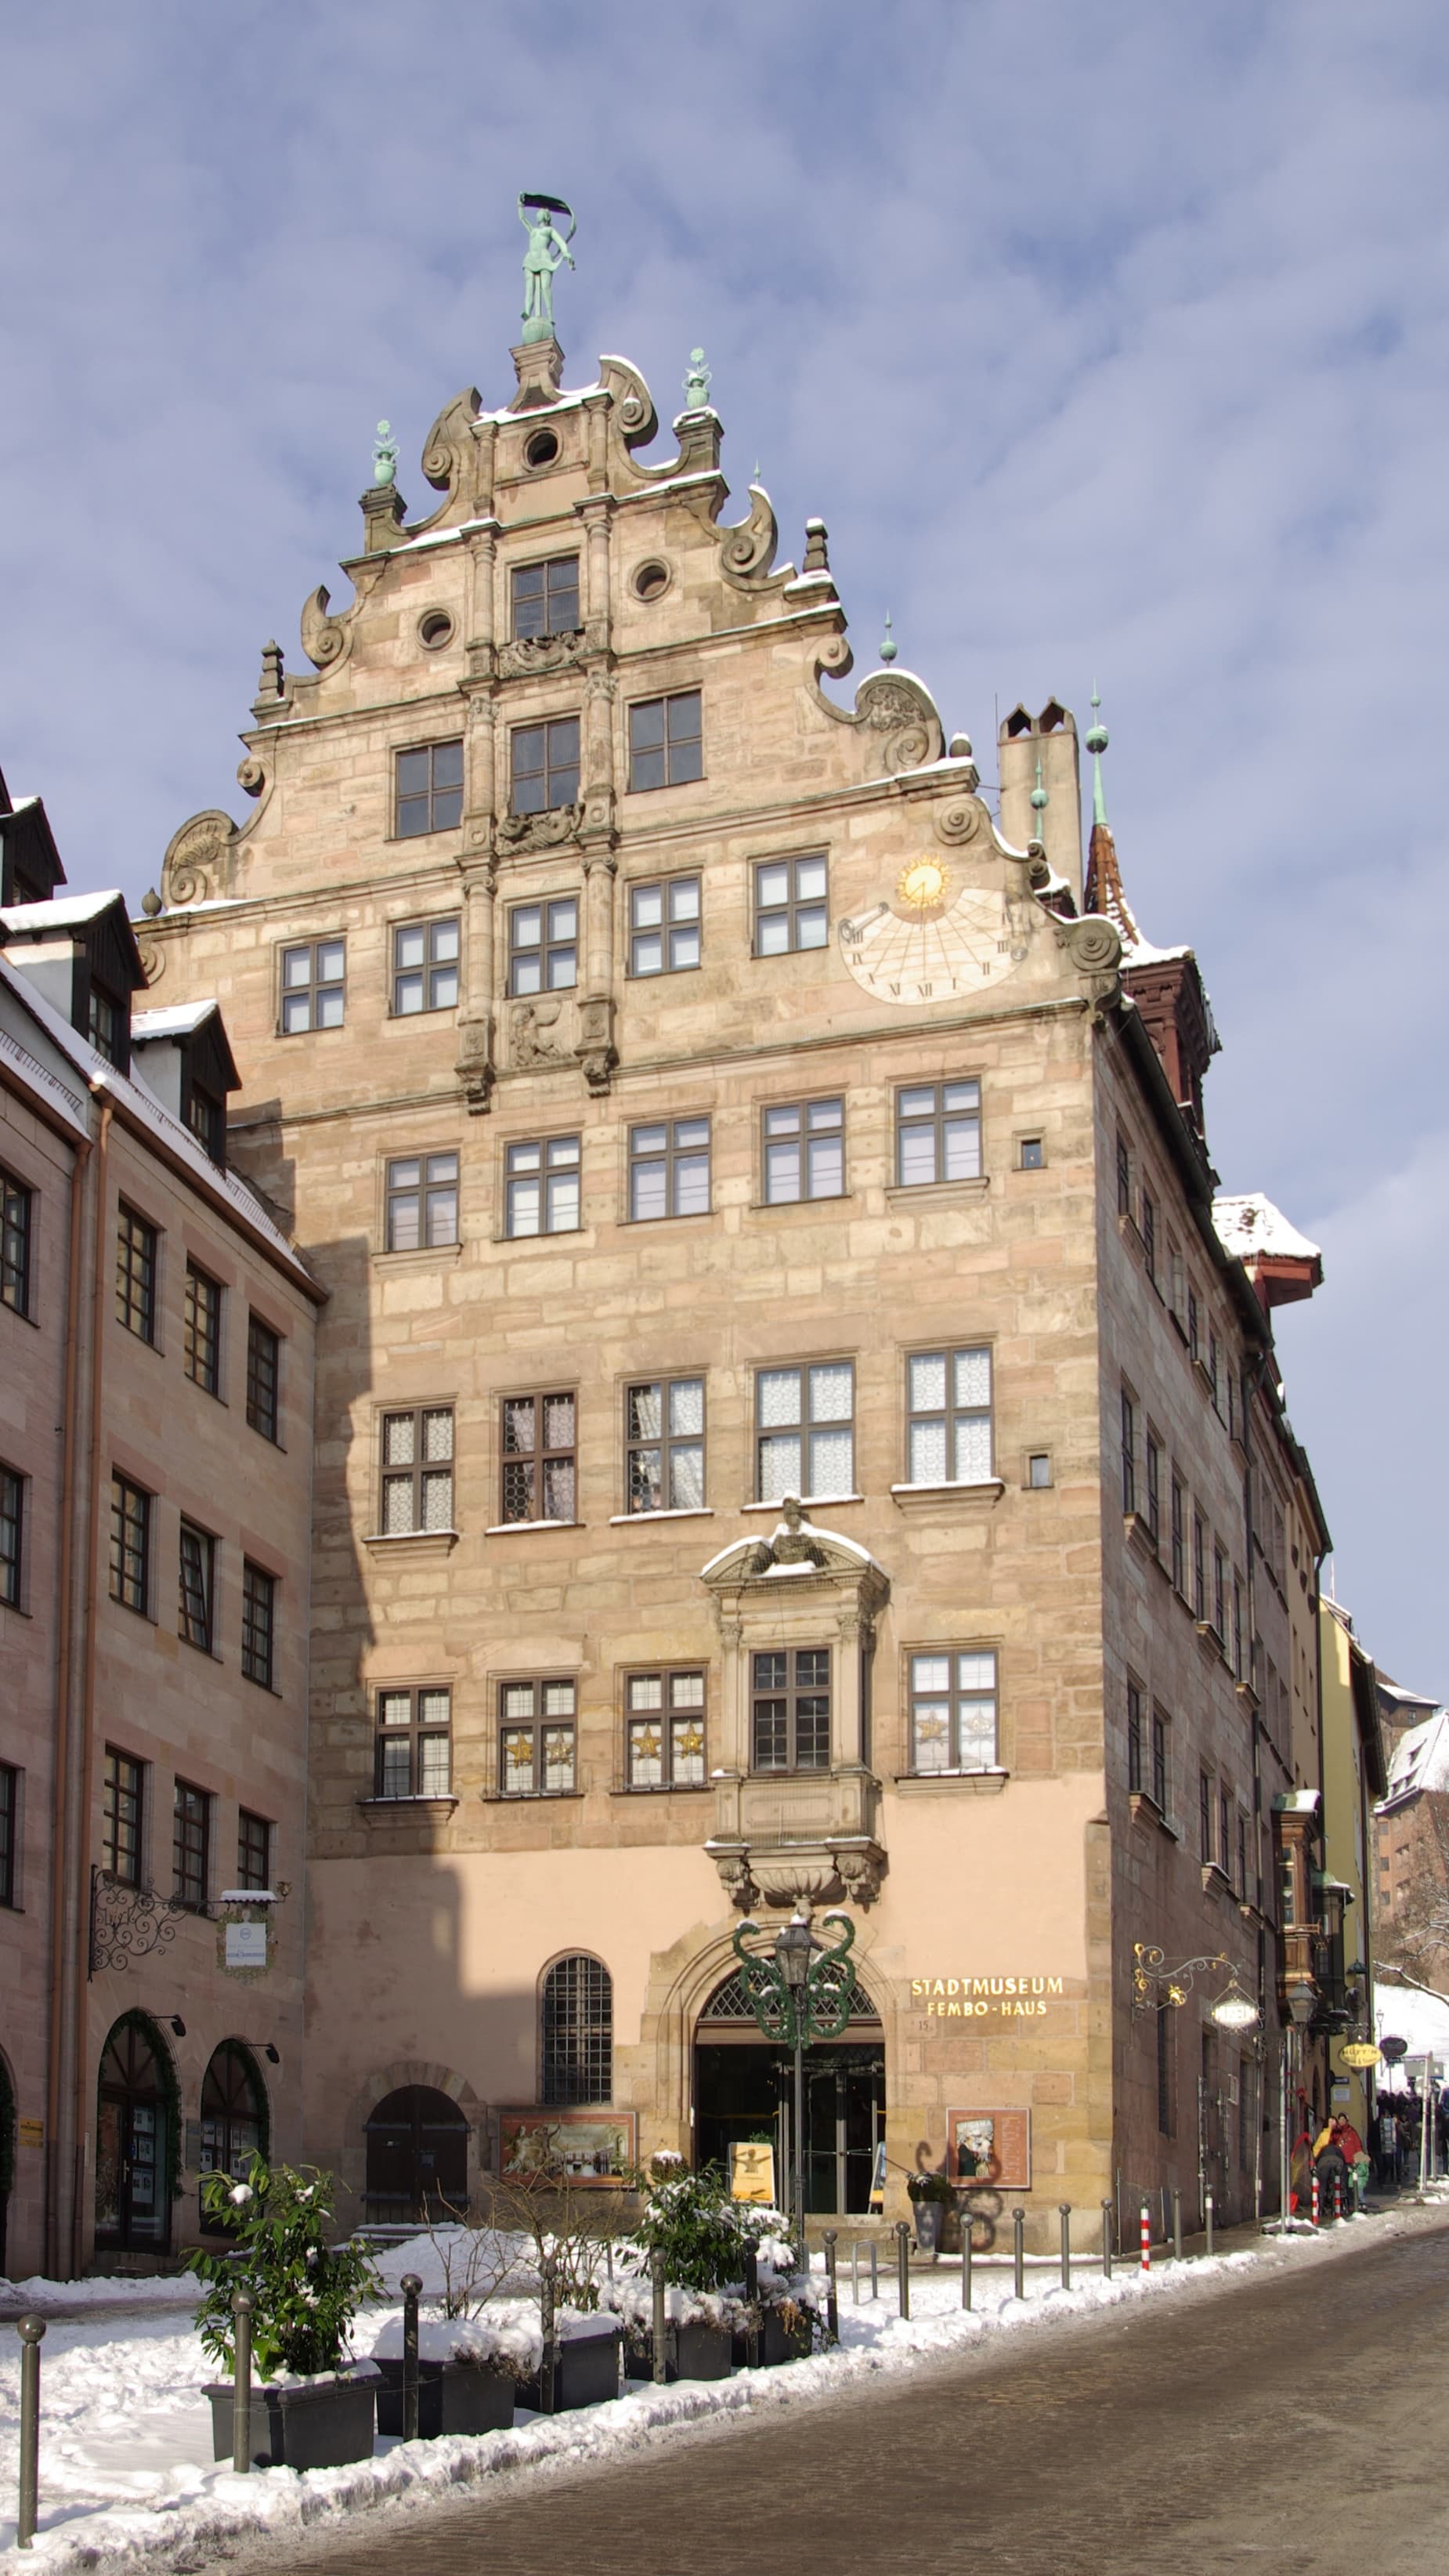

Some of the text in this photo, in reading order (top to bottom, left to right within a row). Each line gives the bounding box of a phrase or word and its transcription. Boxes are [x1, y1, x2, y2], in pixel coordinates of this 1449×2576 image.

[982, 961, 990, 975] II
[889, 983, 901, 996] XI
[917, 982, 932, 997] XII
[911, 1977, 1064, 1995] STADTMUSEUM
[918, 2020, 929, 2031] 15
